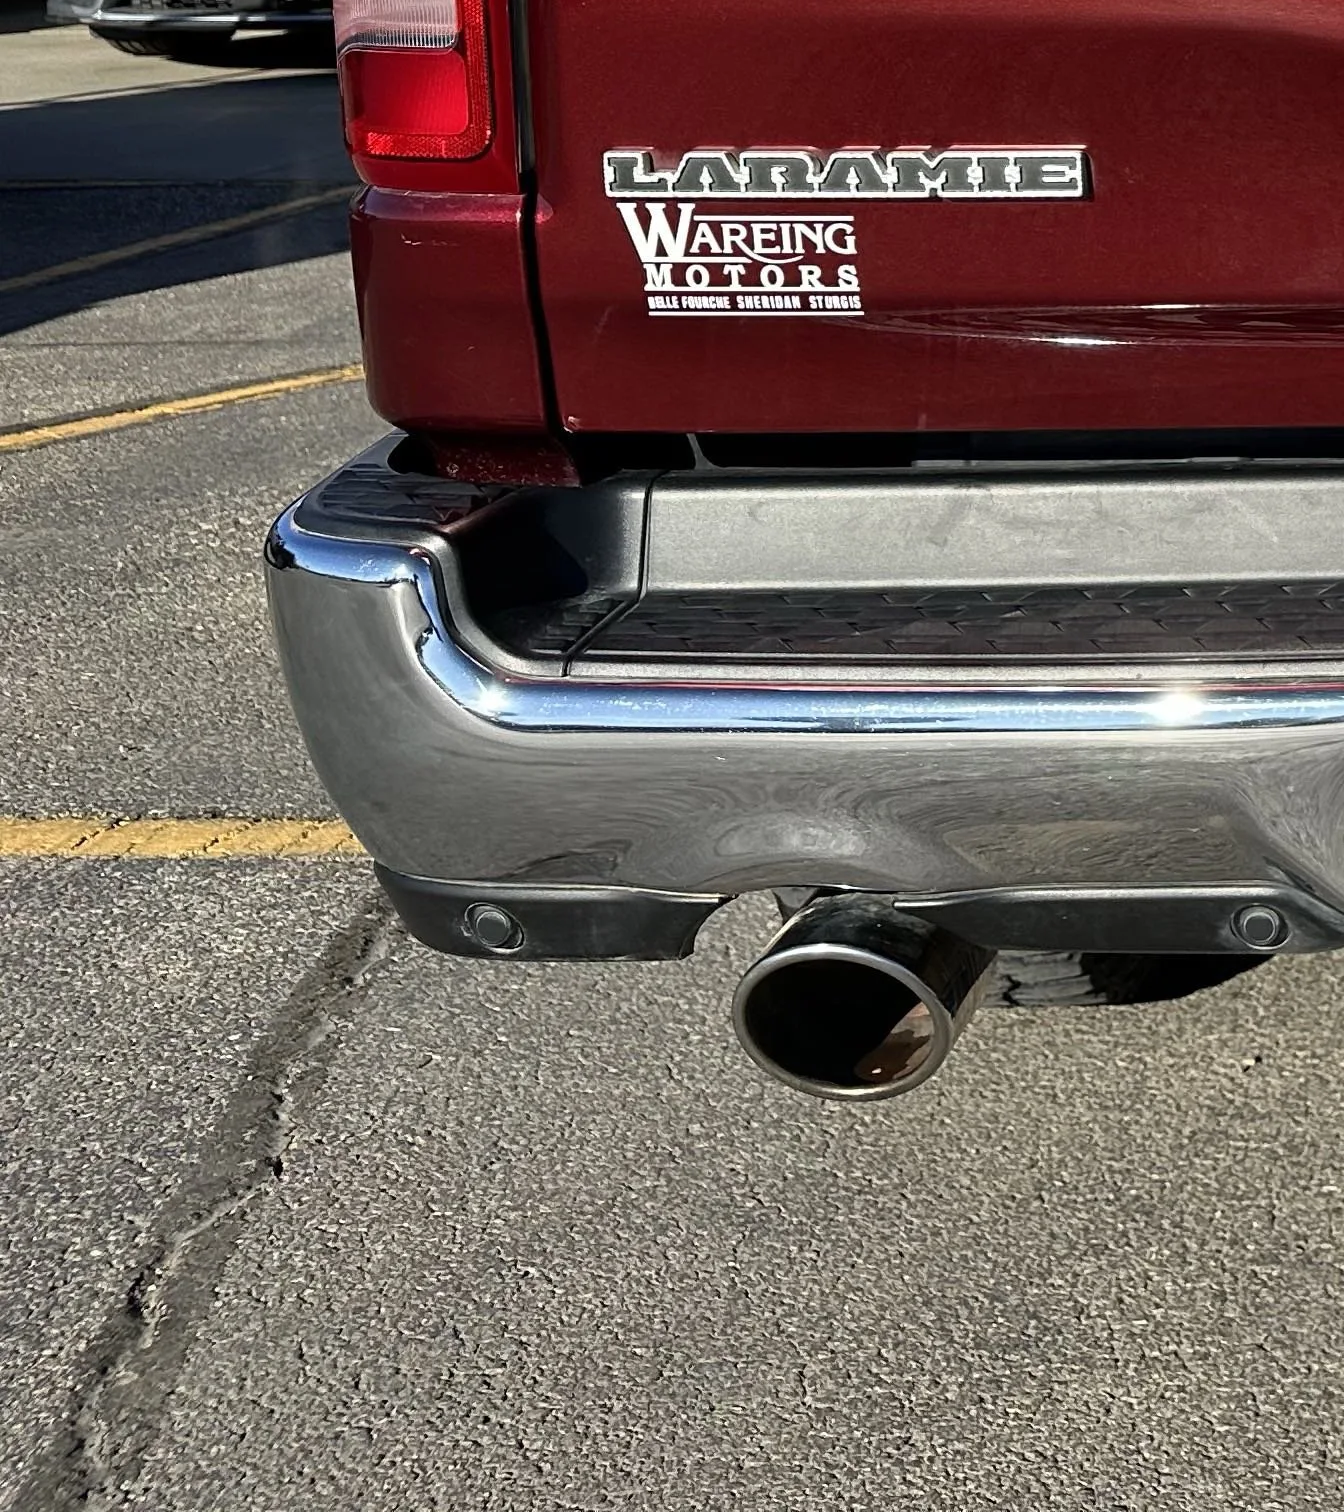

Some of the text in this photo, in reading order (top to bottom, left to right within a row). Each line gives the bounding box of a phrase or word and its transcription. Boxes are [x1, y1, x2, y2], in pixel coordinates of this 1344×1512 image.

[603, 149, 1087, 199] LARAMIE
[616, 202, 858, 263] WAREING
[643, 263, 859, 288] MOTORS
[681, 295, 731, 309] FOURCHE
[736, 295, 801, 309] SHERIDAN
[809, 295, 862, 309] STURGIS
